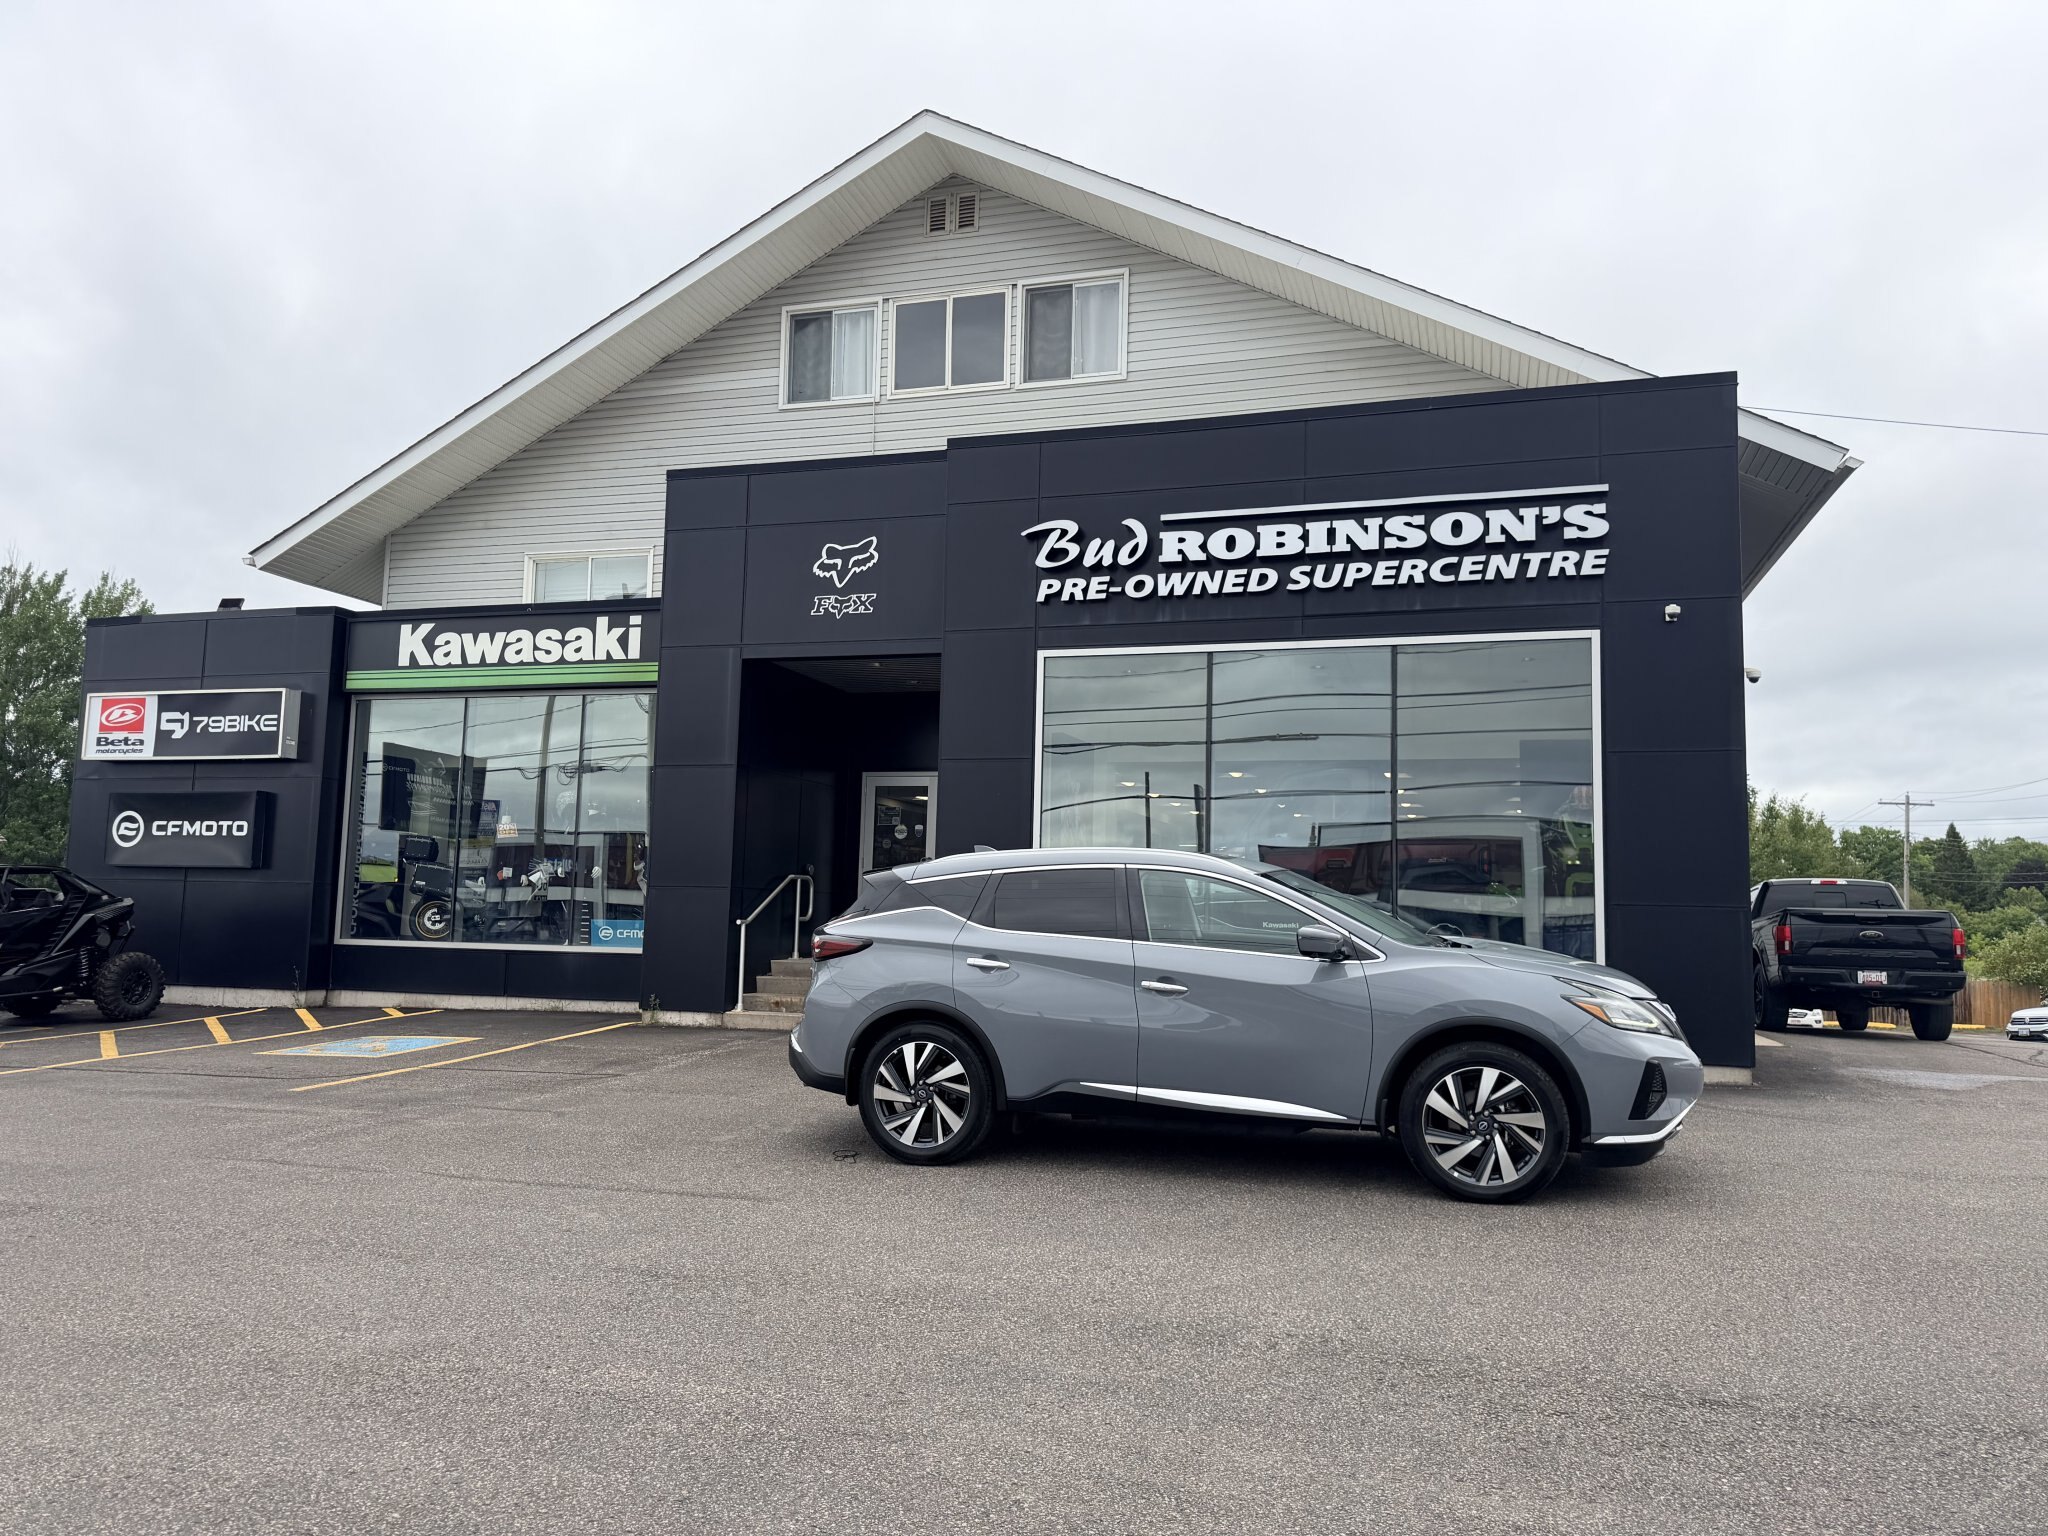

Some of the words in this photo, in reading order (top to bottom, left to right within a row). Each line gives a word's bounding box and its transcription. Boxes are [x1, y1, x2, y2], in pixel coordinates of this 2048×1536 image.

[1021, 519, 1149, 568] Bud
[1159, 503, 1610, 563] ROBINSON'S
[1036, 568, 1278, 603] PRE-OWNED
[1287, 549, 1610, 591] SUPERCENTRE
[398, 615, 643, 667] Kawasaki
[192, 714, 278, 733] 79BIKE
[95, 736, 144, 747] Beta
[151, 820, 249, 836] CFMOTO
[1262, 921, 1299, 929] Kawasaki
